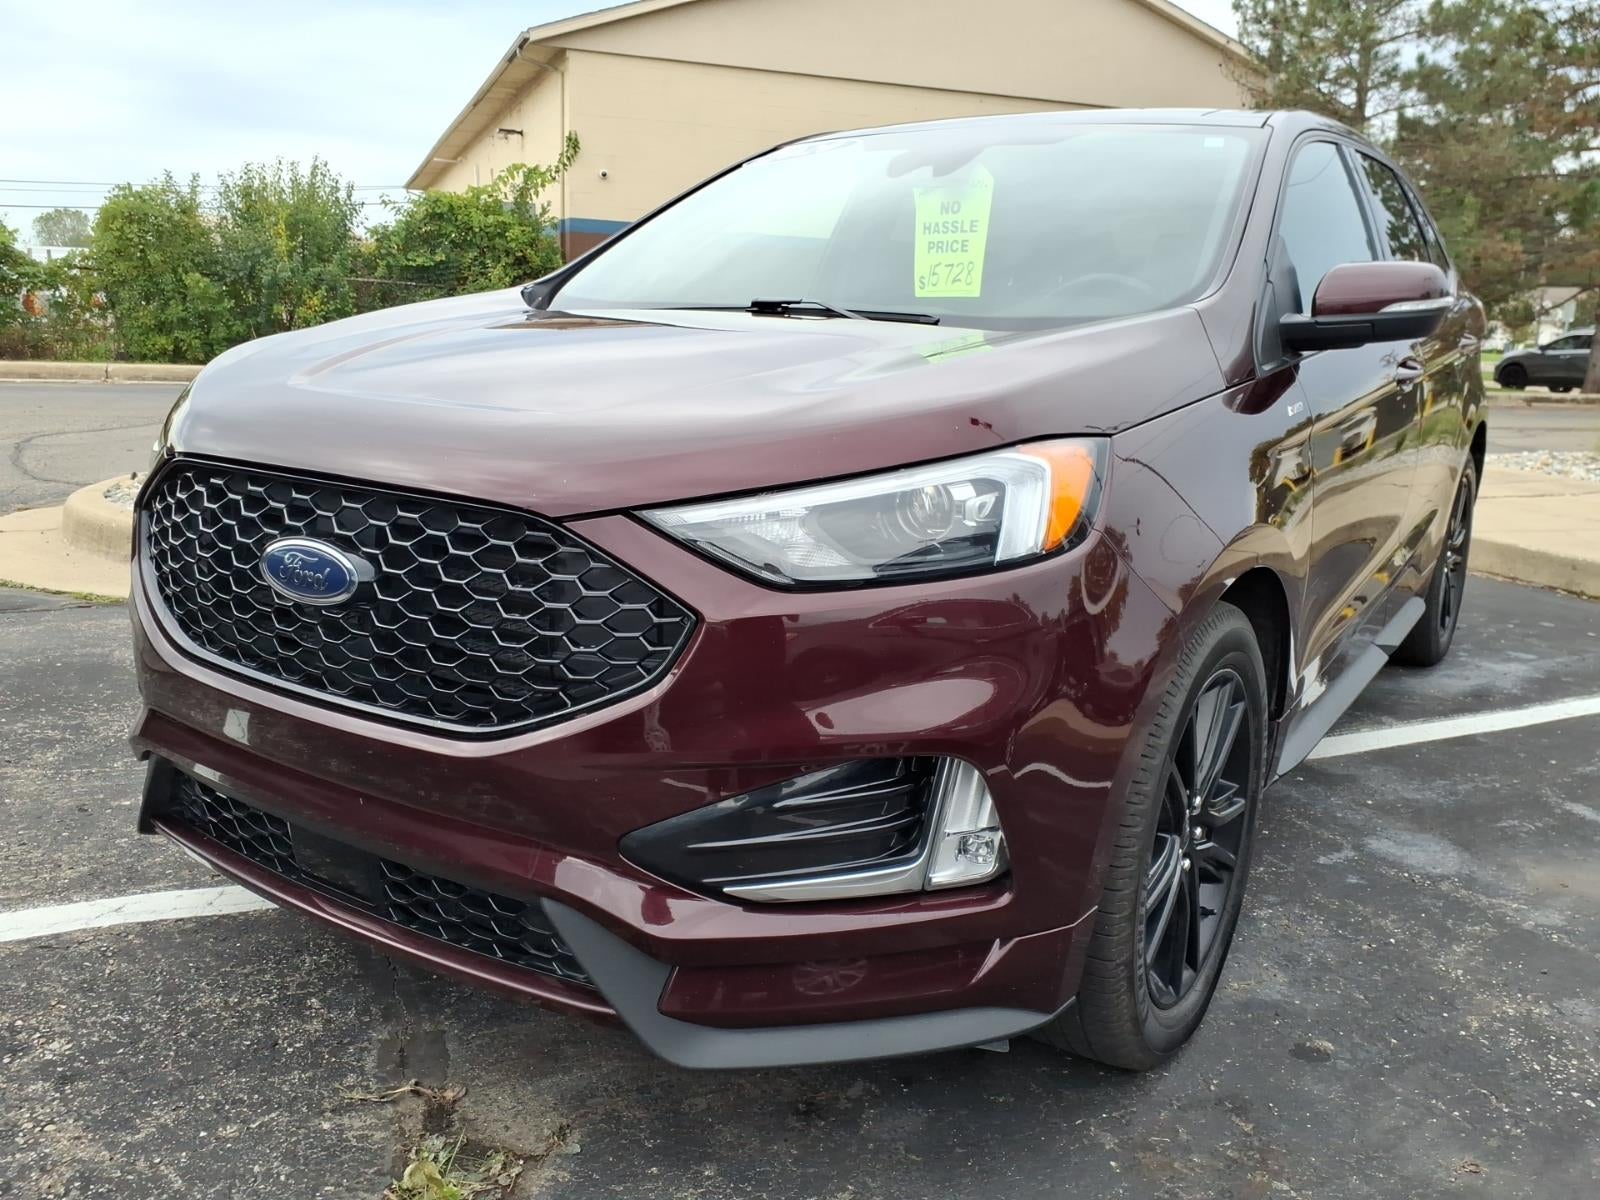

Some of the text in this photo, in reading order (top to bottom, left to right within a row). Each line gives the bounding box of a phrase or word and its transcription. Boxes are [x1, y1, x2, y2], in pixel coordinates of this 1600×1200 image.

[940, 200, 961, 216] NO
[923, 219, 979, 236] HASSLE
[928, 239, 970, 254] PRICE
[279, 551, 331, 591] Ford
